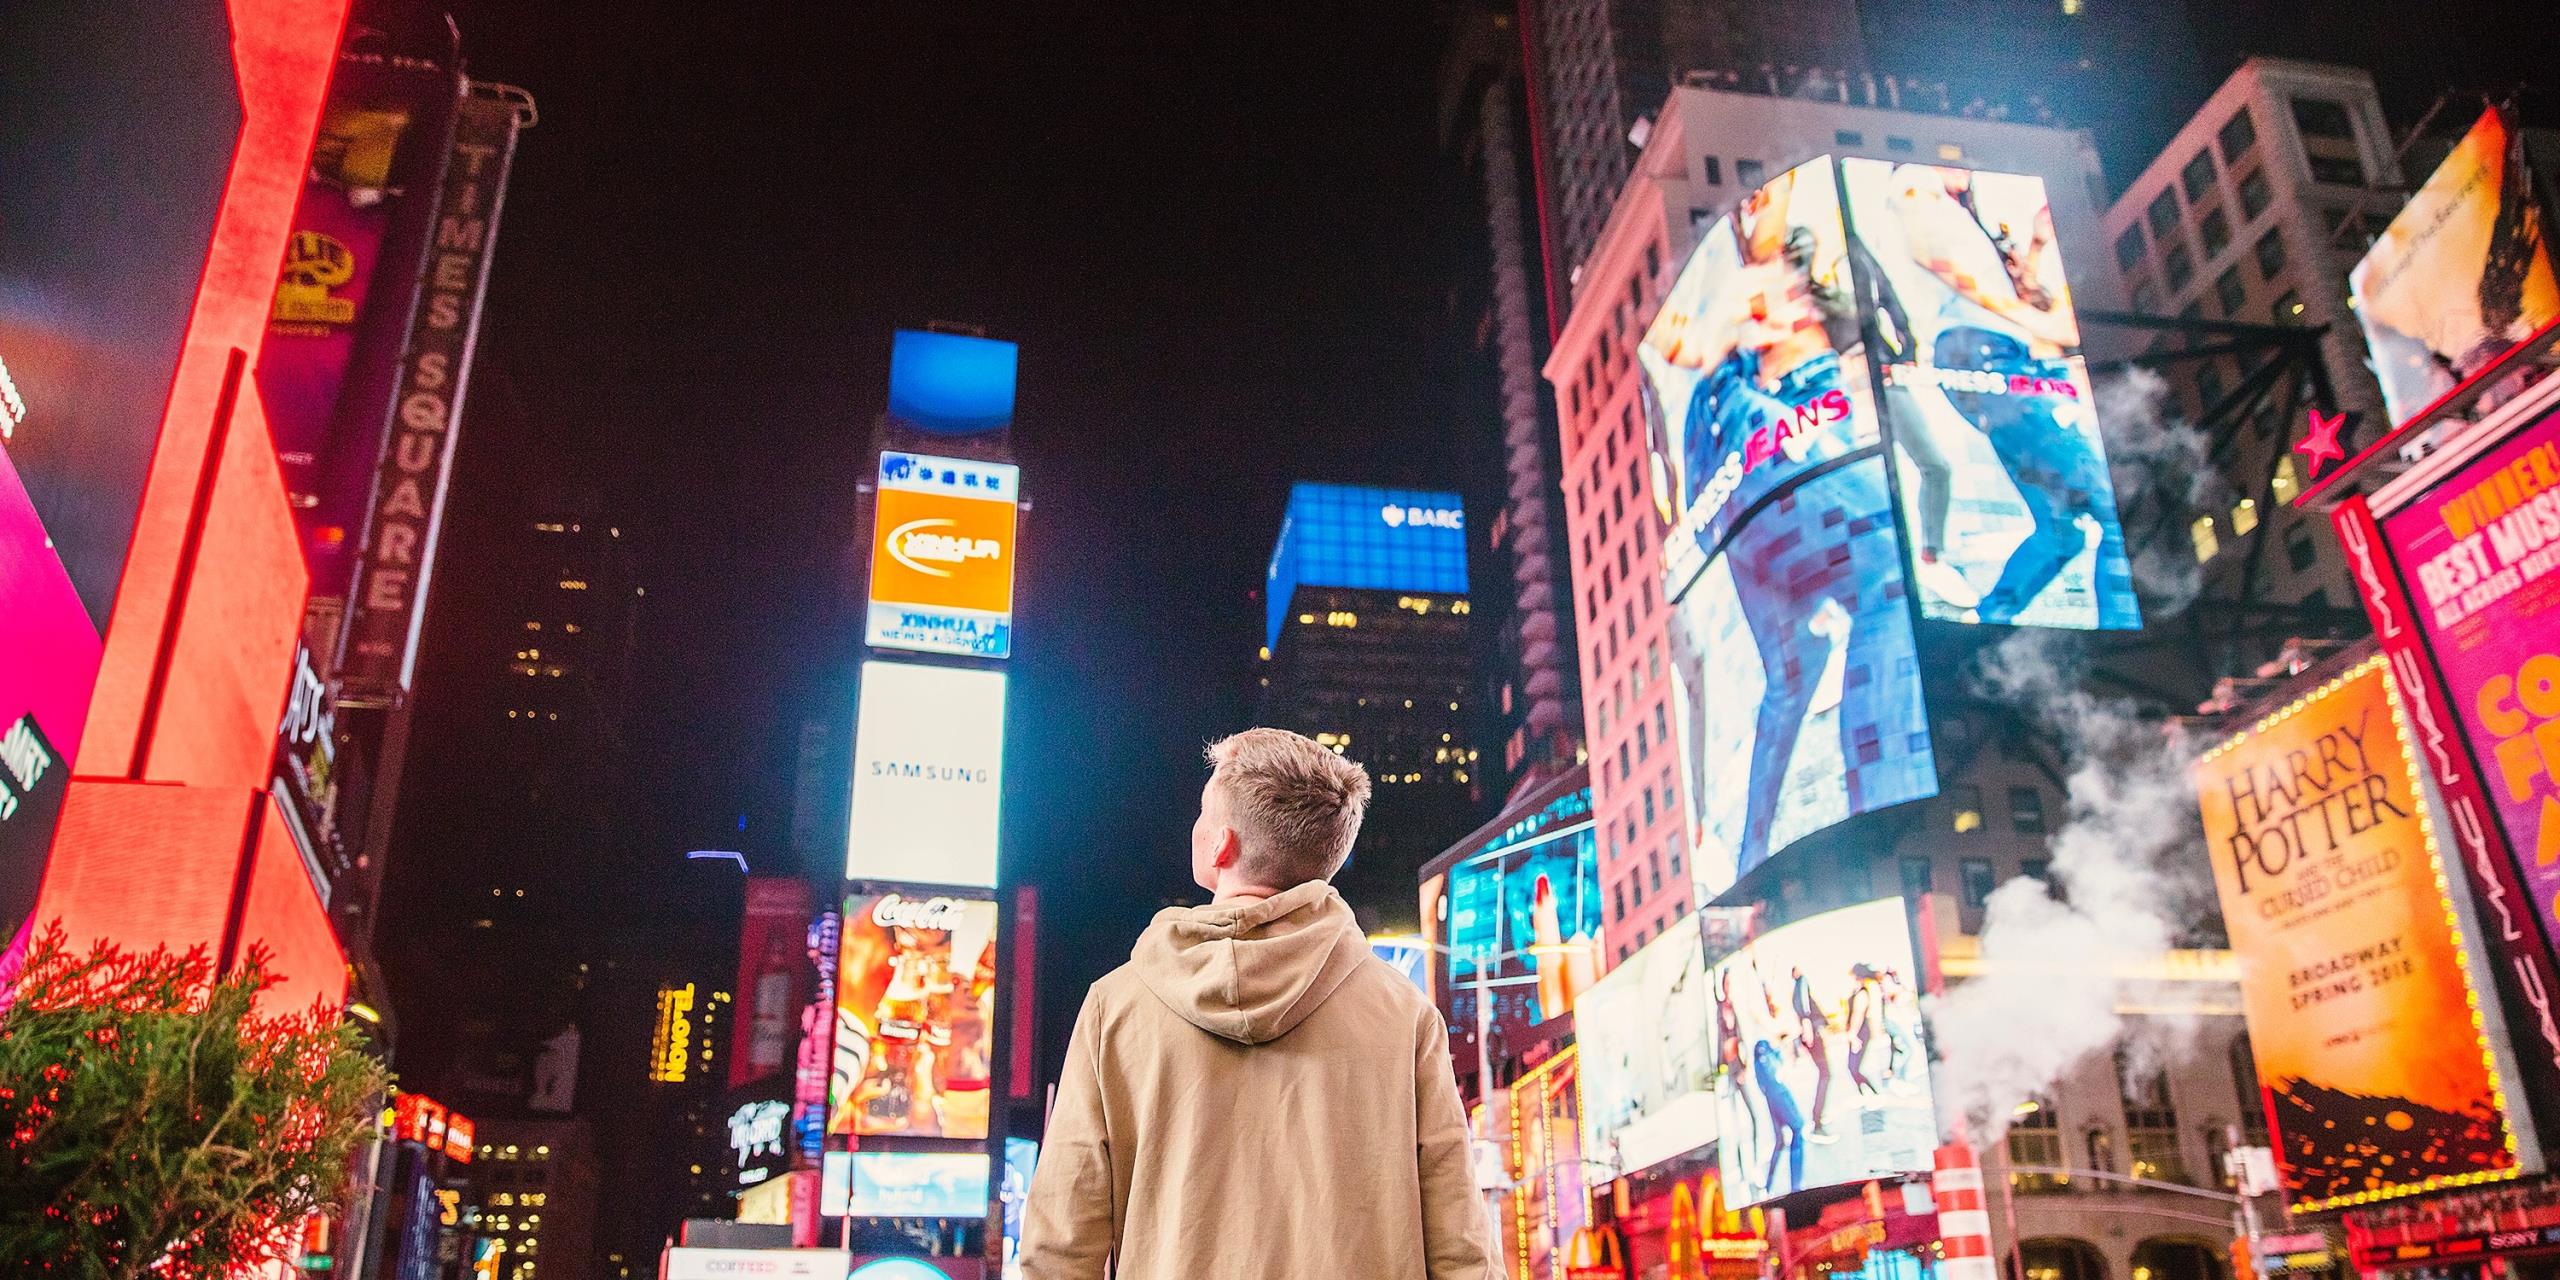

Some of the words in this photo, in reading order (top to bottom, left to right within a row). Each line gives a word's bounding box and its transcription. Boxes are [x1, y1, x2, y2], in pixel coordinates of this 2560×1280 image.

[428, 143, 496, 330] TIMES
[1743, 390, 1849, 473] JEANS
[367, 352, 448, 611] SQUARE
[1408, 507, 1464, 530] BARC
[2417, 531, 2492, 605] BEST
[872, 761, 987, 783] SAMSUNG
[2226, 708, 2370, 833] HARRY
[2229, 773, 2409, 894] POTTER
[2336, 848, 2401, 887] CHILD
[2288, 936, 2402, 988] BROADWAY
[2291, 975, 2362, 1011] SPRING
[664, 982, 695, 1083] NOVOTEL
[2489, 1230, 2538, 1249] SONY
